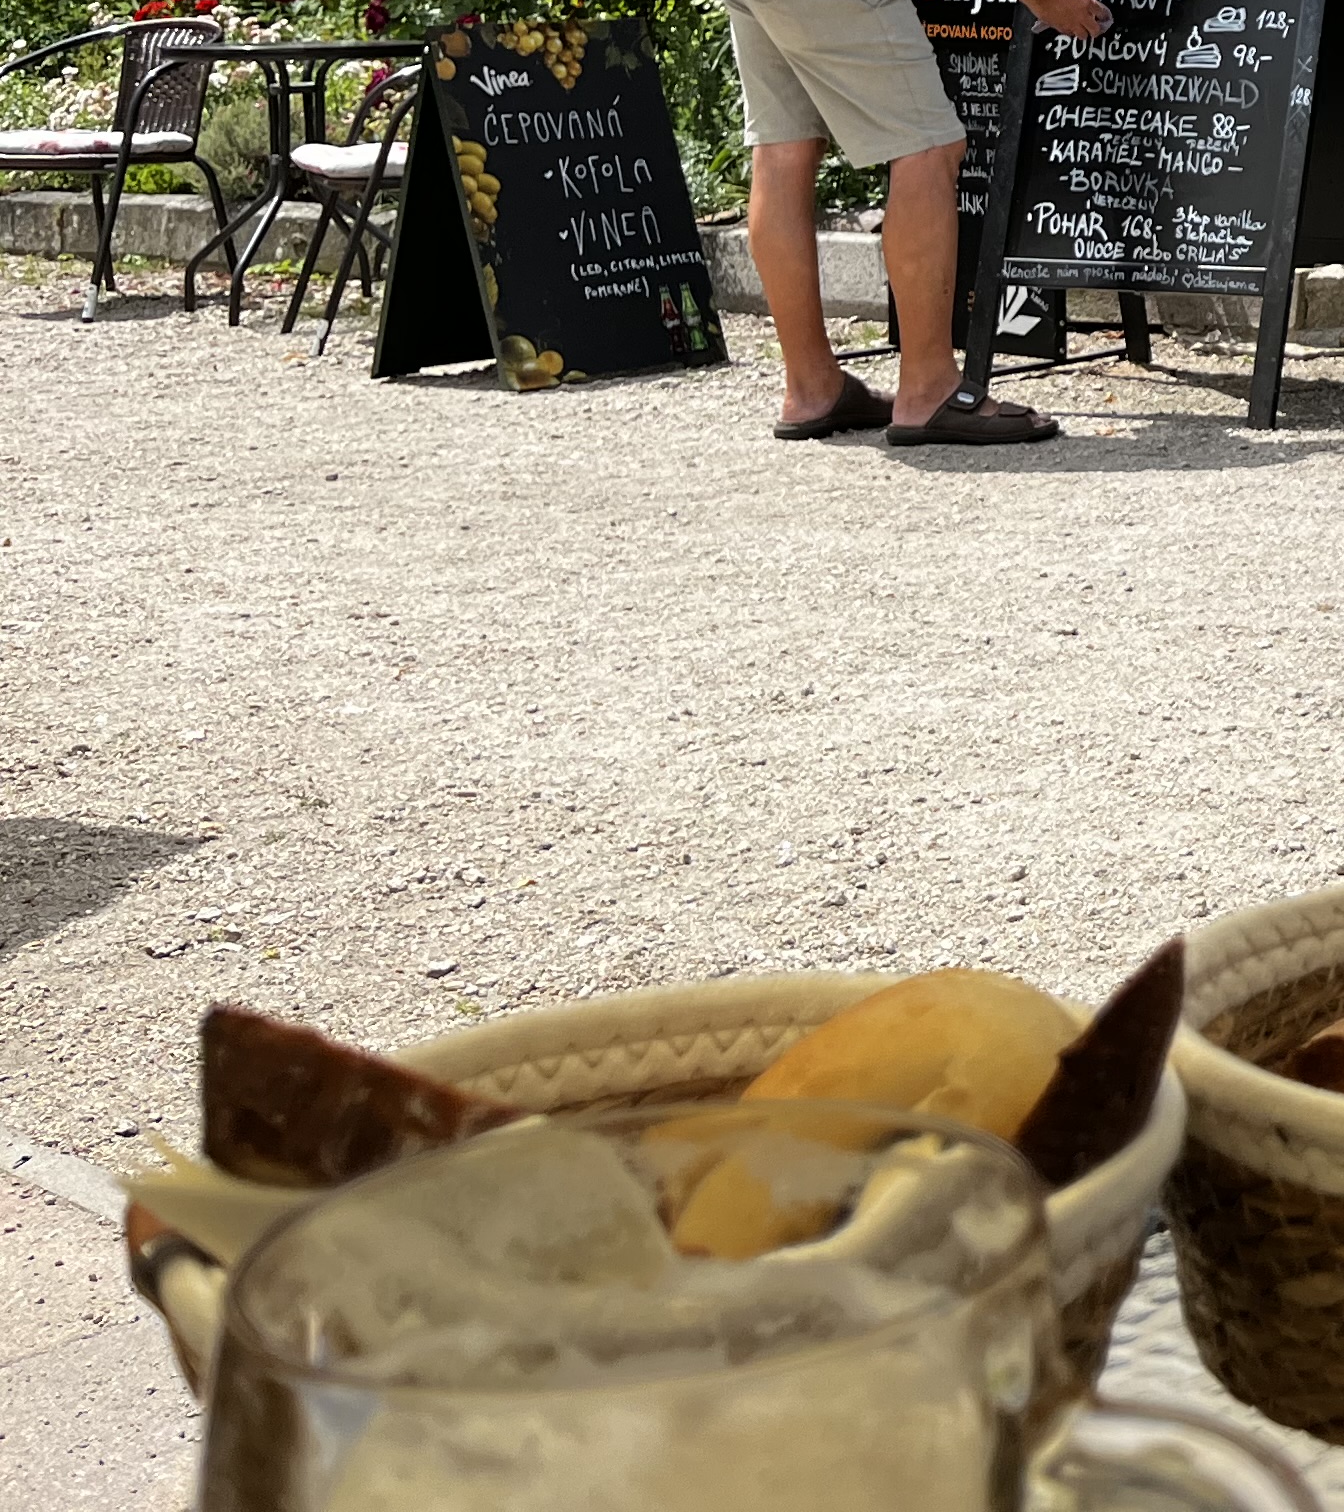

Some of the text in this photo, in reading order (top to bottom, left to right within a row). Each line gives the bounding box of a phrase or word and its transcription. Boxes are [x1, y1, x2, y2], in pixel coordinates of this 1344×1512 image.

[922, 21, 978, 39] EPOVANÁ
[470, 66, 531, 96] Vinea
[1088, 68, 1259, 109] SCHWARZWALD
[483, 95, 623, 146] ČEPOVANÁ
[1045, 105, 1198, 138] CHEESECAKE
[570, 205, 661, 256] VINEA
[1132, 236, 1172, 262] nebo
